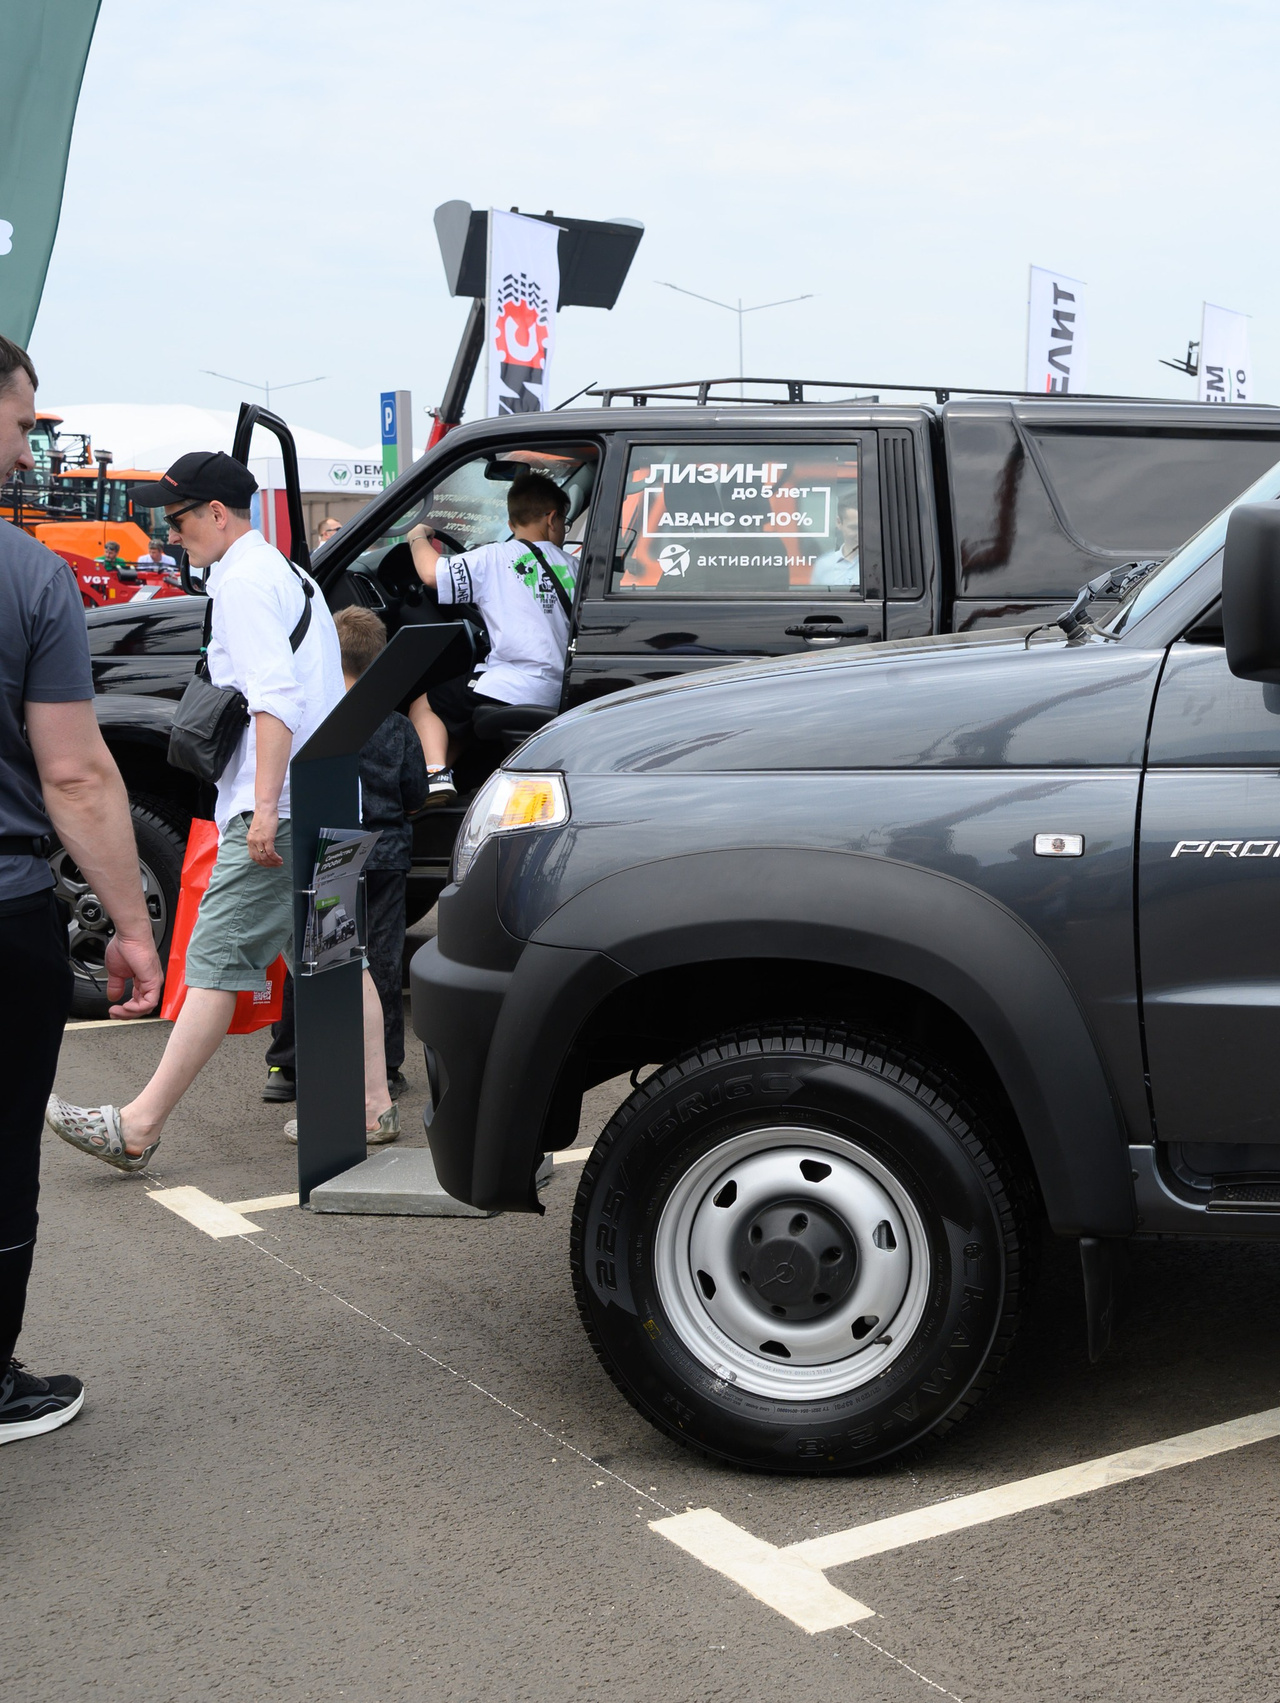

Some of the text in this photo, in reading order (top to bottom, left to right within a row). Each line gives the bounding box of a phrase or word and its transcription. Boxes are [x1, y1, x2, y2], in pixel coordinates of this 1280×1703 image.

[644, 463, 788, 484] ЛИЗИНГ
[731, 486, 810, 500] до 5 лет
[658, 511, 813, 527] АВАНС от 10%
[697, 554, 817, 567] активлизинг
[83, 575, 110, 584] VGT
